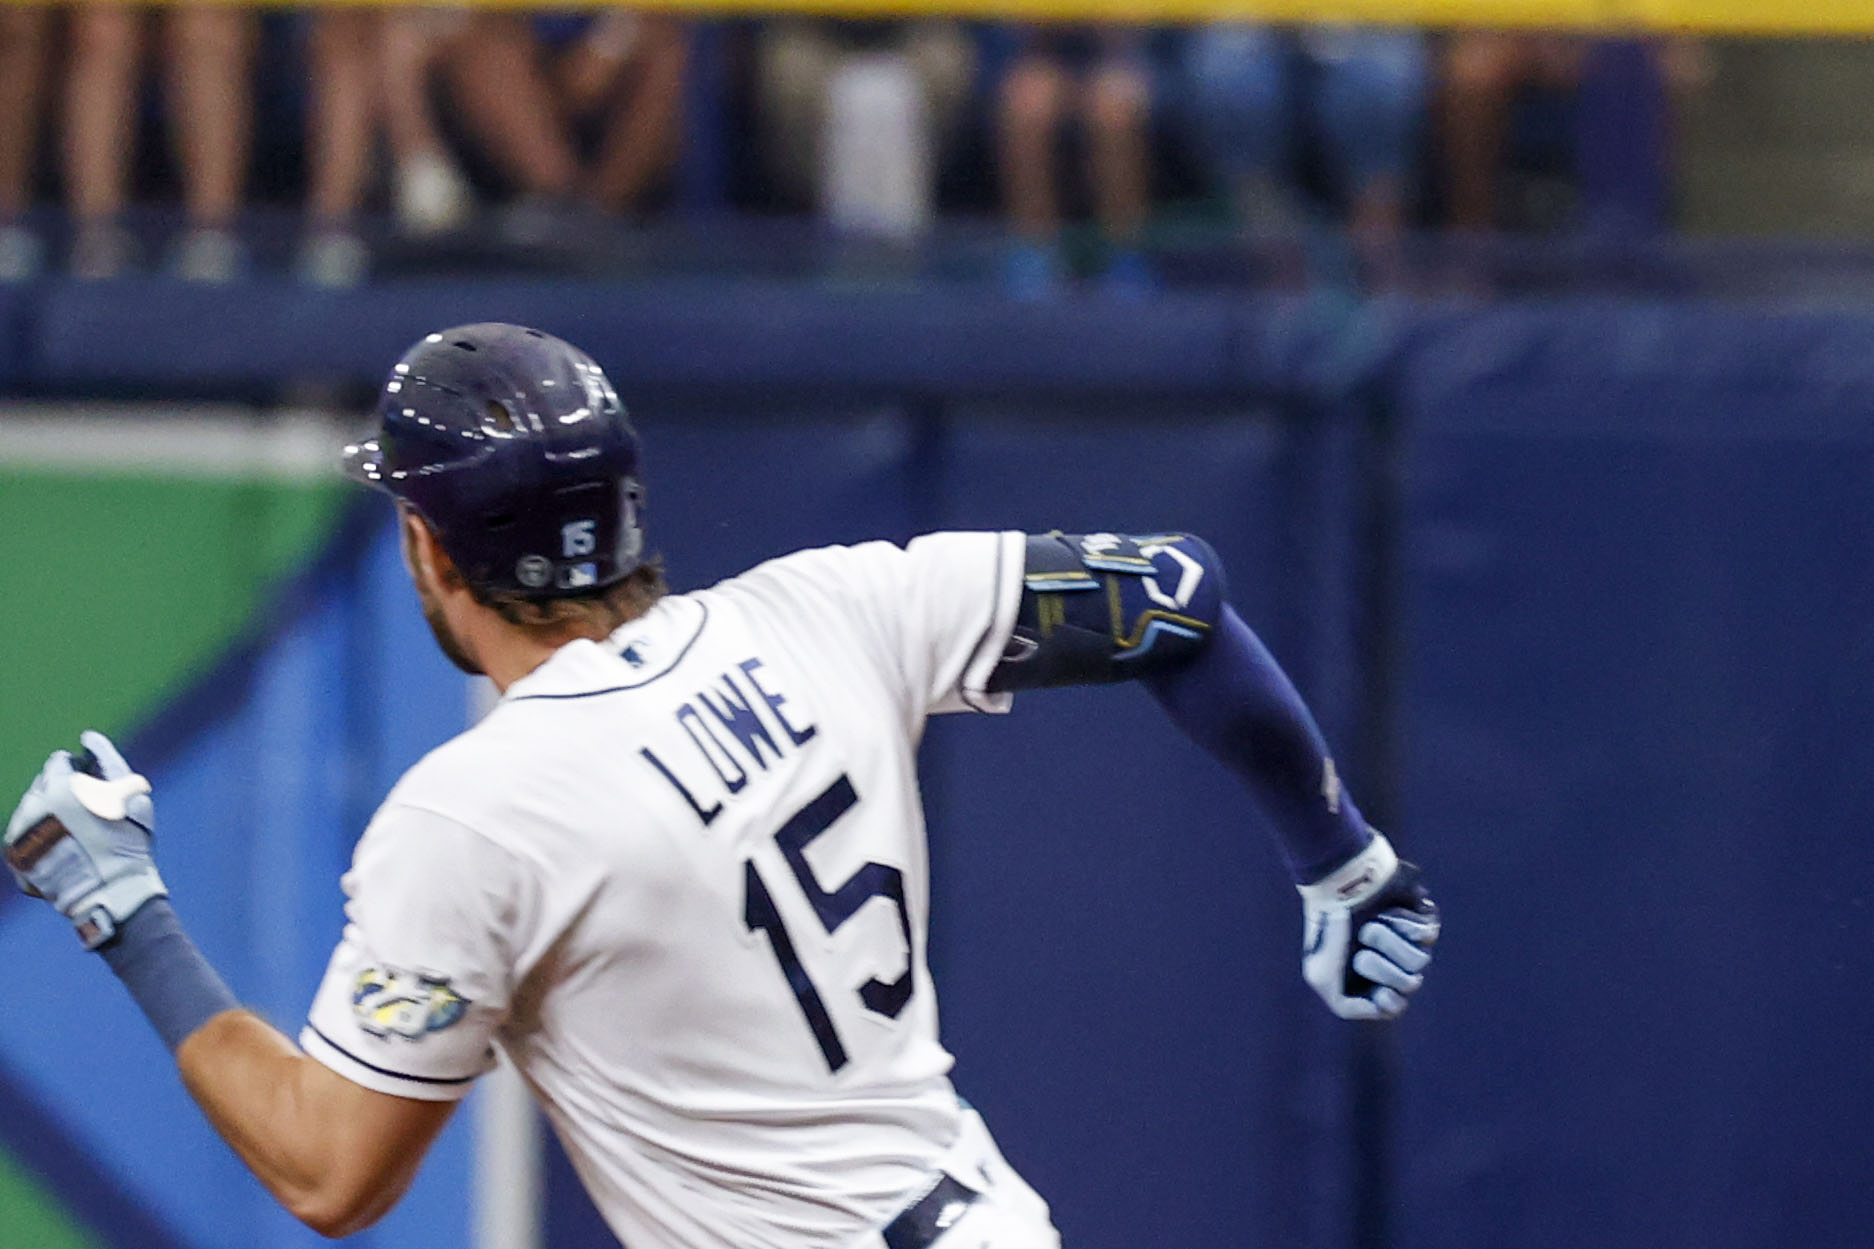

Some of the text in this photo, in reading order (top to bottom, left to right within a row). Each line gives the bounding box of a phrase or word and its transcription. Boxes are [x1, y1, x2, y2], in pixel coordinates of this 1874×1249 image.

[561, 519, 597, 558] 15
[639, 656, 817, 827] LOWE
[743, 771, 914, 1075] 15
